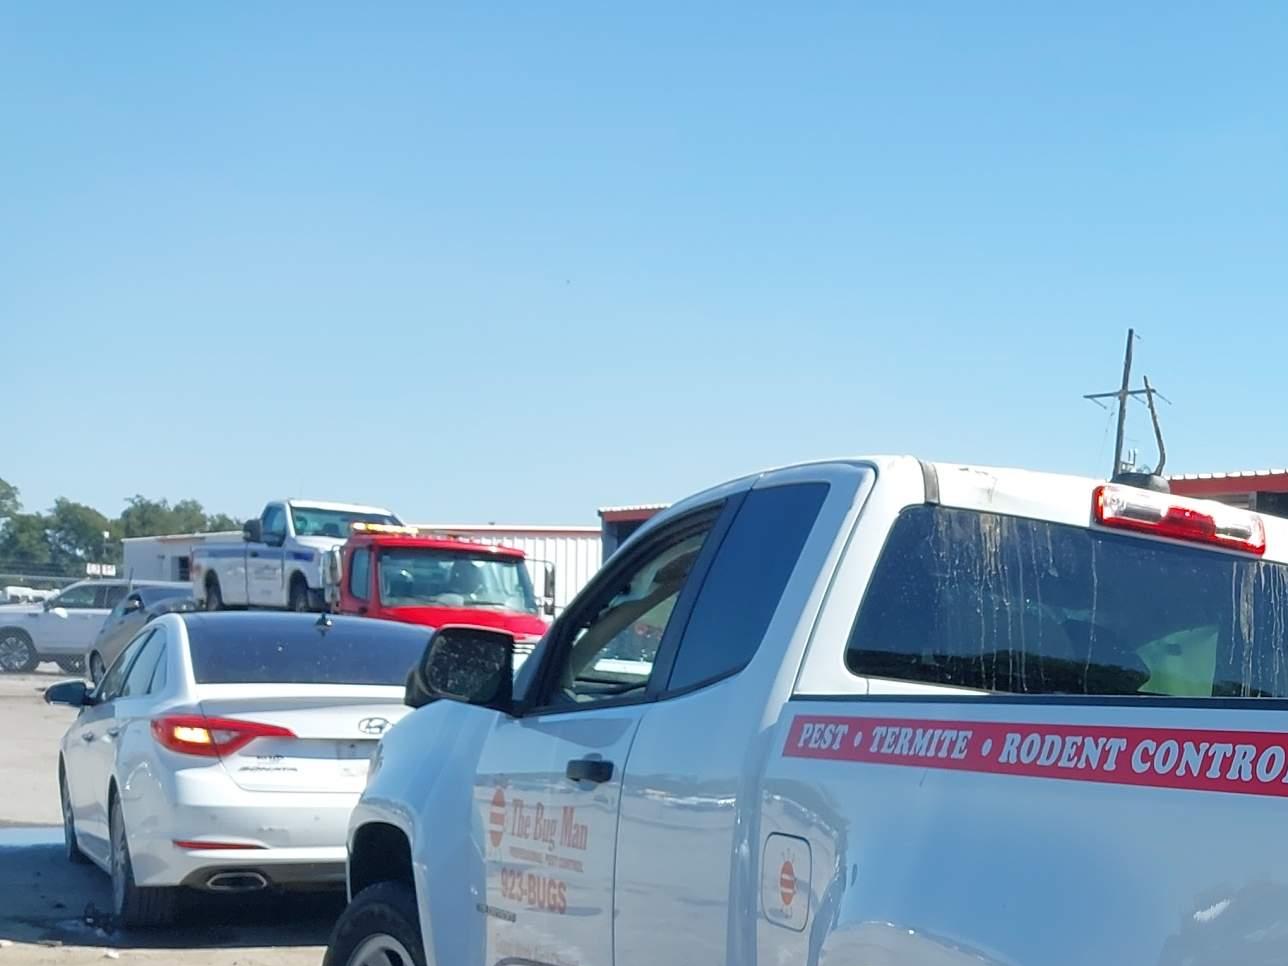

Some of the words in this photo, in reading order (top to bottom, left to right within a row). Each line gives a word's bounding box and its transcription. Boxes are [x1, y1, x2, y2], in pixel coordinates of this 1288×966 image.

[798, 721, 848, 752] PEST
[869, 725, 973, 760] TERMITE
[999, 731, 1127, 771] RODENT
[511, 798, 531, 840] The
[533, 801, 558, 852] Bug
[560, 805, 589, 851] Man
[501, 867, 567, 915] 923-BUGS
